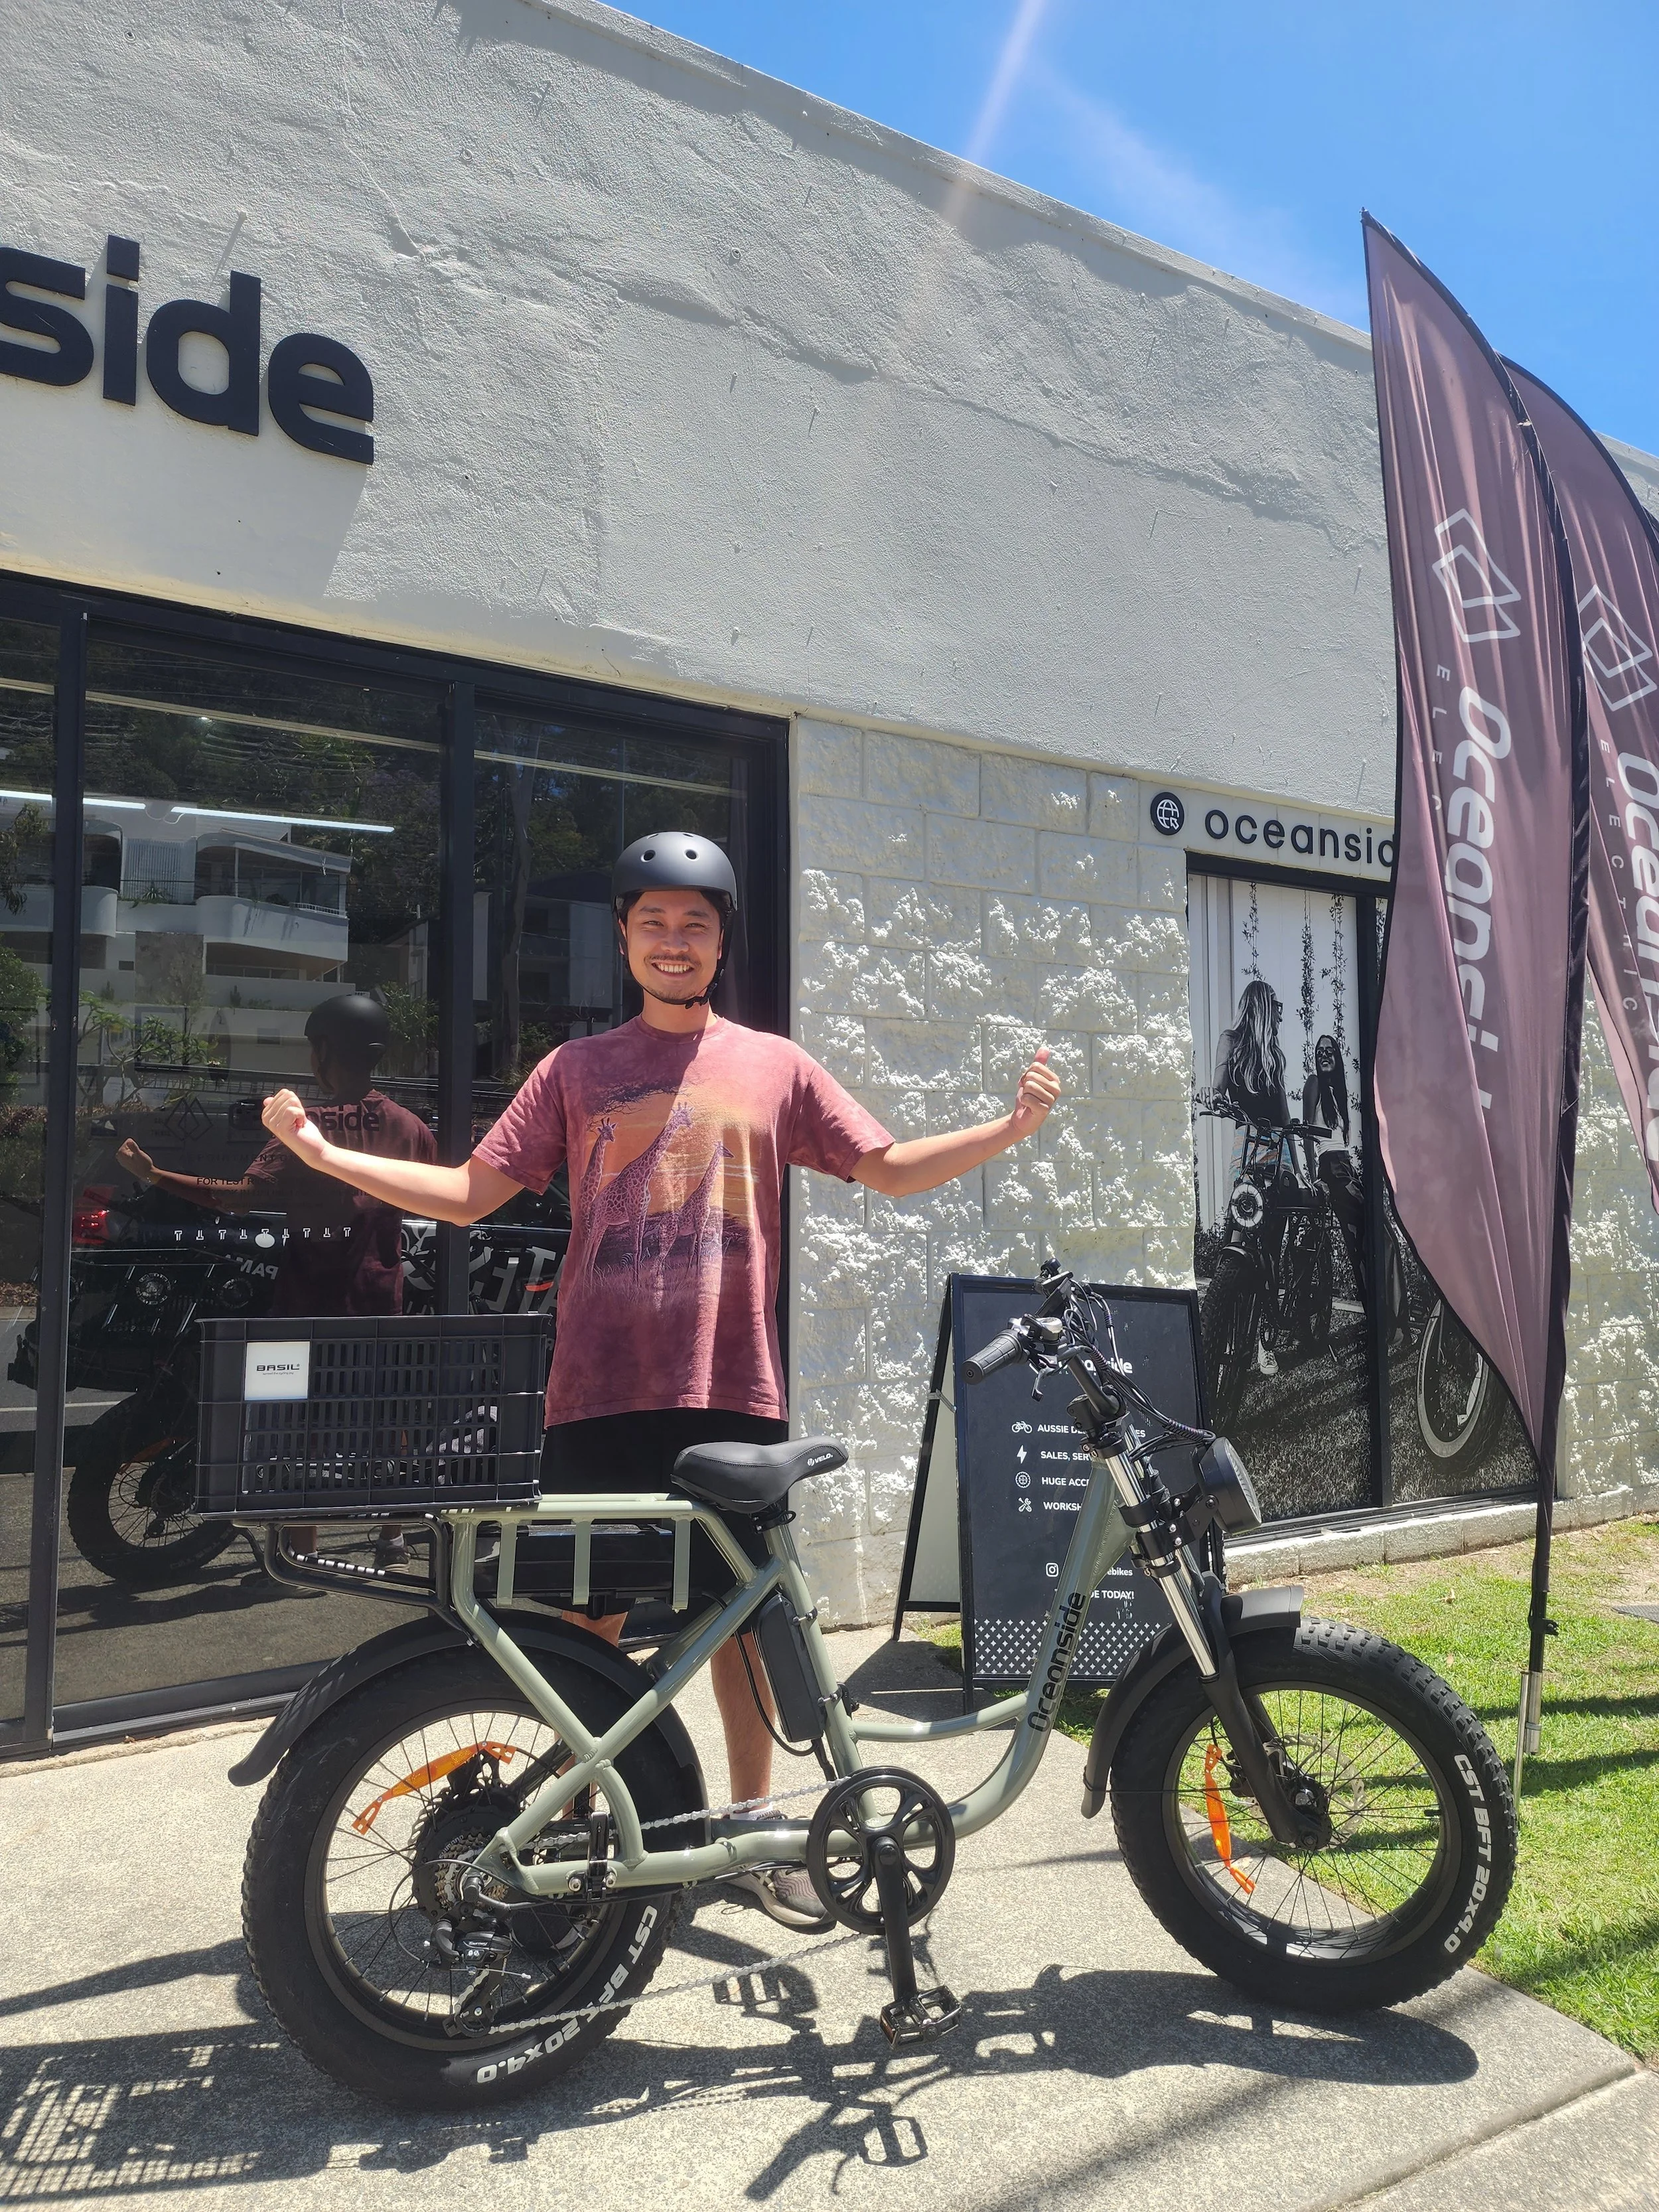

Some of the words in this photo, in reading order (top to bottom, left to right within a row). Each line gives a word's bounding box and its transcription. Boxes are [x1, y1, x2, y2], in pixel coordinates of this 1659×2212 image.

[0, 234, 374, 465] side
[196, 1177, 218, 1186] FOR
[1037, 1424, 1069, 1434] AUSSIE
[815, 1453, 831, 1463] VELO
[1041, 1451, 1070, 1461] SALES,
[1042, 1477, 1066, 1486] HUGE
[1102, 1590, 1135, 1600] TODAY!
[1028, 1591, 1087, 1732] Oceanside
[1454, 1754, 1485, 1801] CST
[1474, 1807, 1492, 1862] BFT
[628, 1905, 658, 1964] CST
